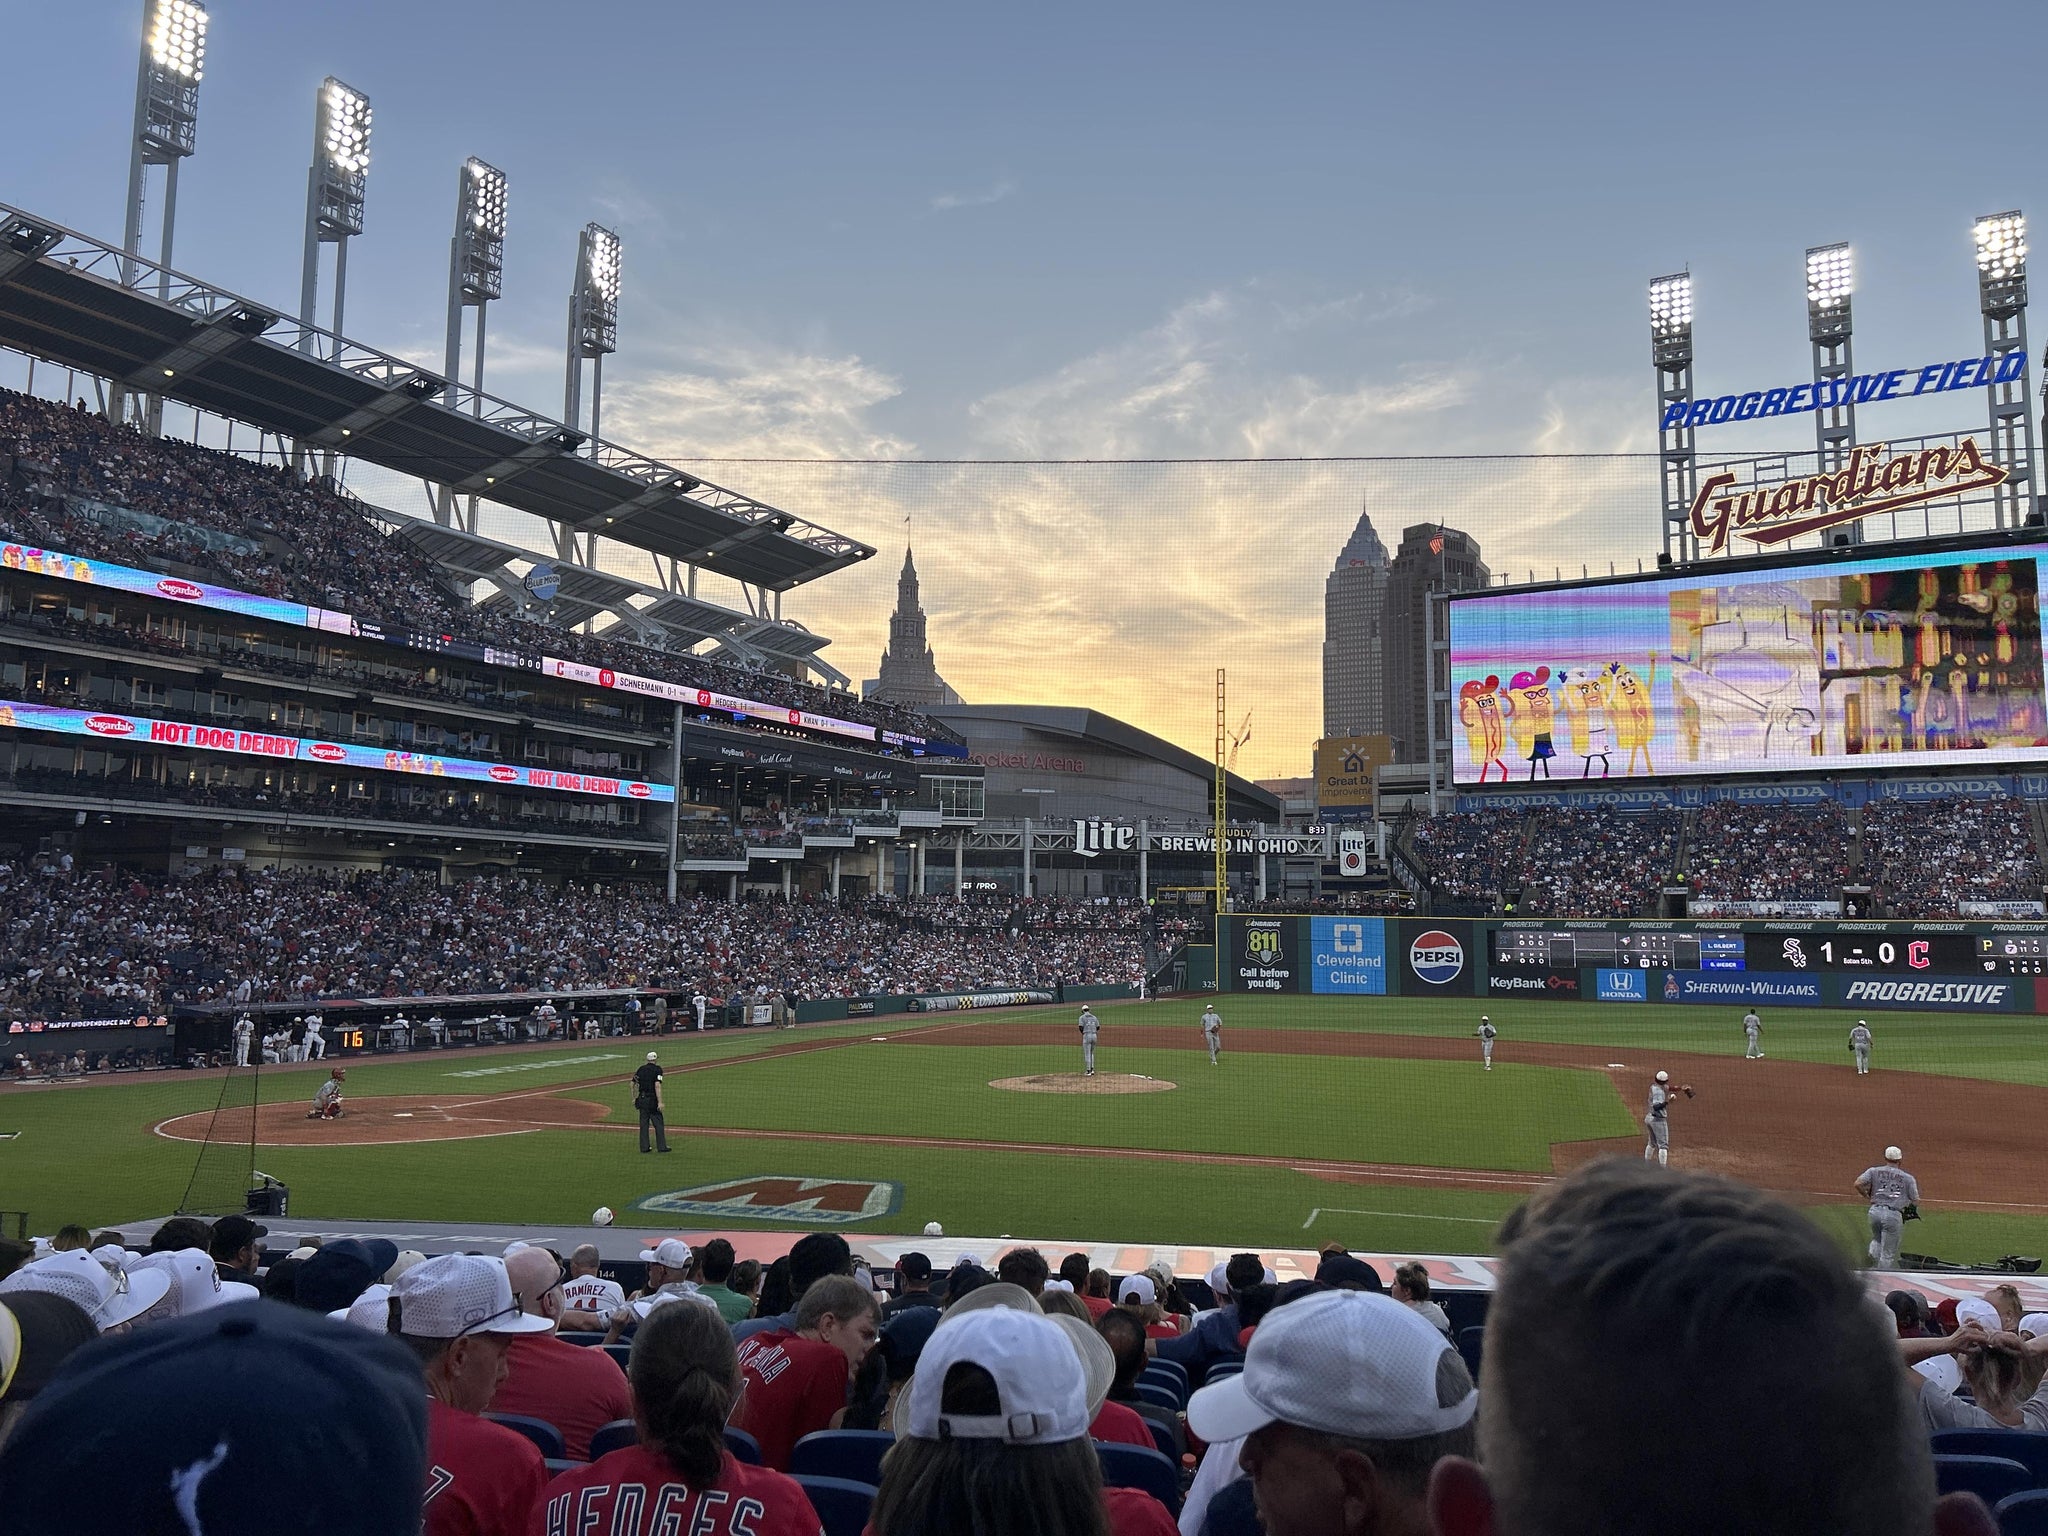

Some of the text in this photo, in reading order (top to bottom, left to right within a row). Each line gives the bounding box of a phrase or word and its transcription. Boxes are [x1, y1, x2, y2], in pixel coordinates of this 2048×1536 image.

[1659, 350, 2029, 432] PROGRESSIVE FIELD
[1689, 435, 2009, 556] Guardians
[158, 581, 202, 598] Sugardale
[362, 623, 381, 632] CHICAGO
[361, 631, 385, 640] CLEVELAND
[556, 662, 564, 676] C
[602, 673, 612, 684] 10
[619, 677, 677, 696] SCHNEEMANN 0-1
[700, 693, 709, 703] 27
[715, 697, 737, 710] HEDGES
[790, 712, 799, 723] 38
[803, 716, 819, 727] KWAN
[86, 717, 134, 734] Sugardale
[151, 721, 299, 757] HOT DOG DERBY
[310, 746, 347, 760] Sugardale
[722, 747, 745, 757] KeyBank
[969, 751, 1085, 772] ocket Arena
[488, 768, 518, 779] Sugardale
[834, 766, 853, 774] KeyBank
[528, 769, 621, 794] HOT DOG DERBY
[1328, 775, 1358, 786] Great
[1737, 784, 1828, 799] HONDA
[1904, 780, 2005, 795] HONDA
[1485, 794, 1561, 808] HONDA
[1589, 791, 1671, 804] HONDA
[1308, 826, 1326, 834] 8:33
[1072, 819, 1135, 858] Lite
[1161, 837, 1299, 854] BREWED IN OHIO
[1342, 839, 1364, 852] Lite
[1837, 923, 1888, 931] PROGRESSIVE
[1250, 931, 1278, 952] 811
[1982, 940, 1993, 951] P
[1413, 951, 1460, 963] PEPSI
[1820, 942, 1832, 963] 1
[1878, 942, 1895, 964] 0
[1908, 941, 1930, 969] C
[1316, 954, 1381, 967] Cleveland
[1623, 955, 1629, 965] S
[1861, 957, 1873, 965] 5th
[1240, 967, 1289, 978] Call before
[1330, 971, 1368, 984] Clinic
[1202, 980, 1216, 989] 325
[1248, 978, 1282, 990] you dig.
[1490, 977, 1546, 989] KeyBank
[1846, 981, 2005, 1004] PROGRESSIVE
[49, 1021, 69, 1029] HAPPY
[71, 1019, 118, 1028] INDEPENDENCE
[565, 1283, 605, 1298] RAMÍREZ
[574, 1298, 597, 1310] 11
[546, 1482, 764, 1536] HEDGES
